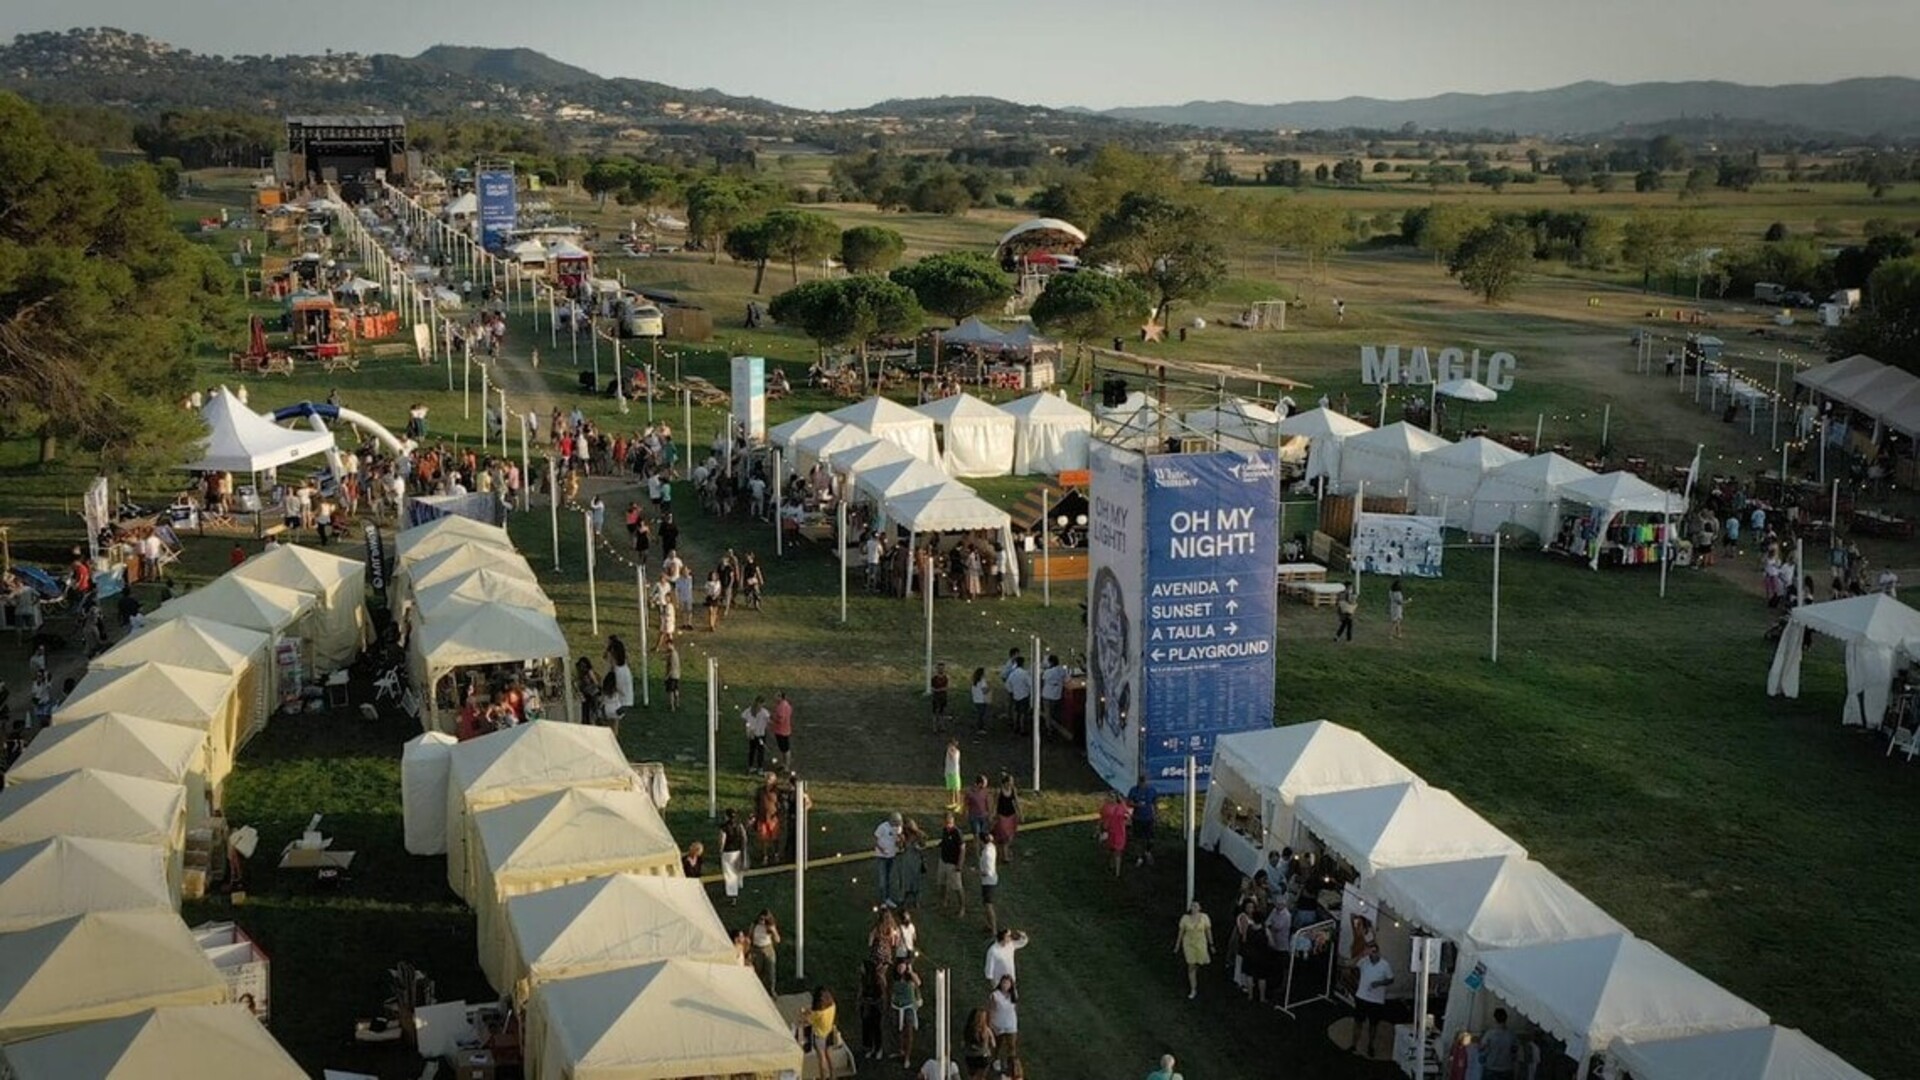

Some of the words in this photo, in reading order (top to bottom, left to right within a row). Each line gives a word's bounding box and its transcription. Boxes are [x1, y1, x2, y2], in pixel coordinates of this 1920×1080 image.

[1361, 344, 1516, 391] MAGIC
[1095, 496, 1109, 520] OH
[1111, 503, 1128, 529] MY
[1170, 510, 1210, 534] OH
[1216, 507, 1256, 531] MY
[1094, 519, 1126, 554] LIGHT!
[1170, 532, 1255, 559] NIGHT!
[1151, 580, 1220, 597] AVENIDA
[1151, 602, 1213, 619] SUNSET
[1151, 627, 1163, 641] A
[1167, 623, 1216, 640] TAULA
[1168, 640, 1270, 661] PLAYGROUND
